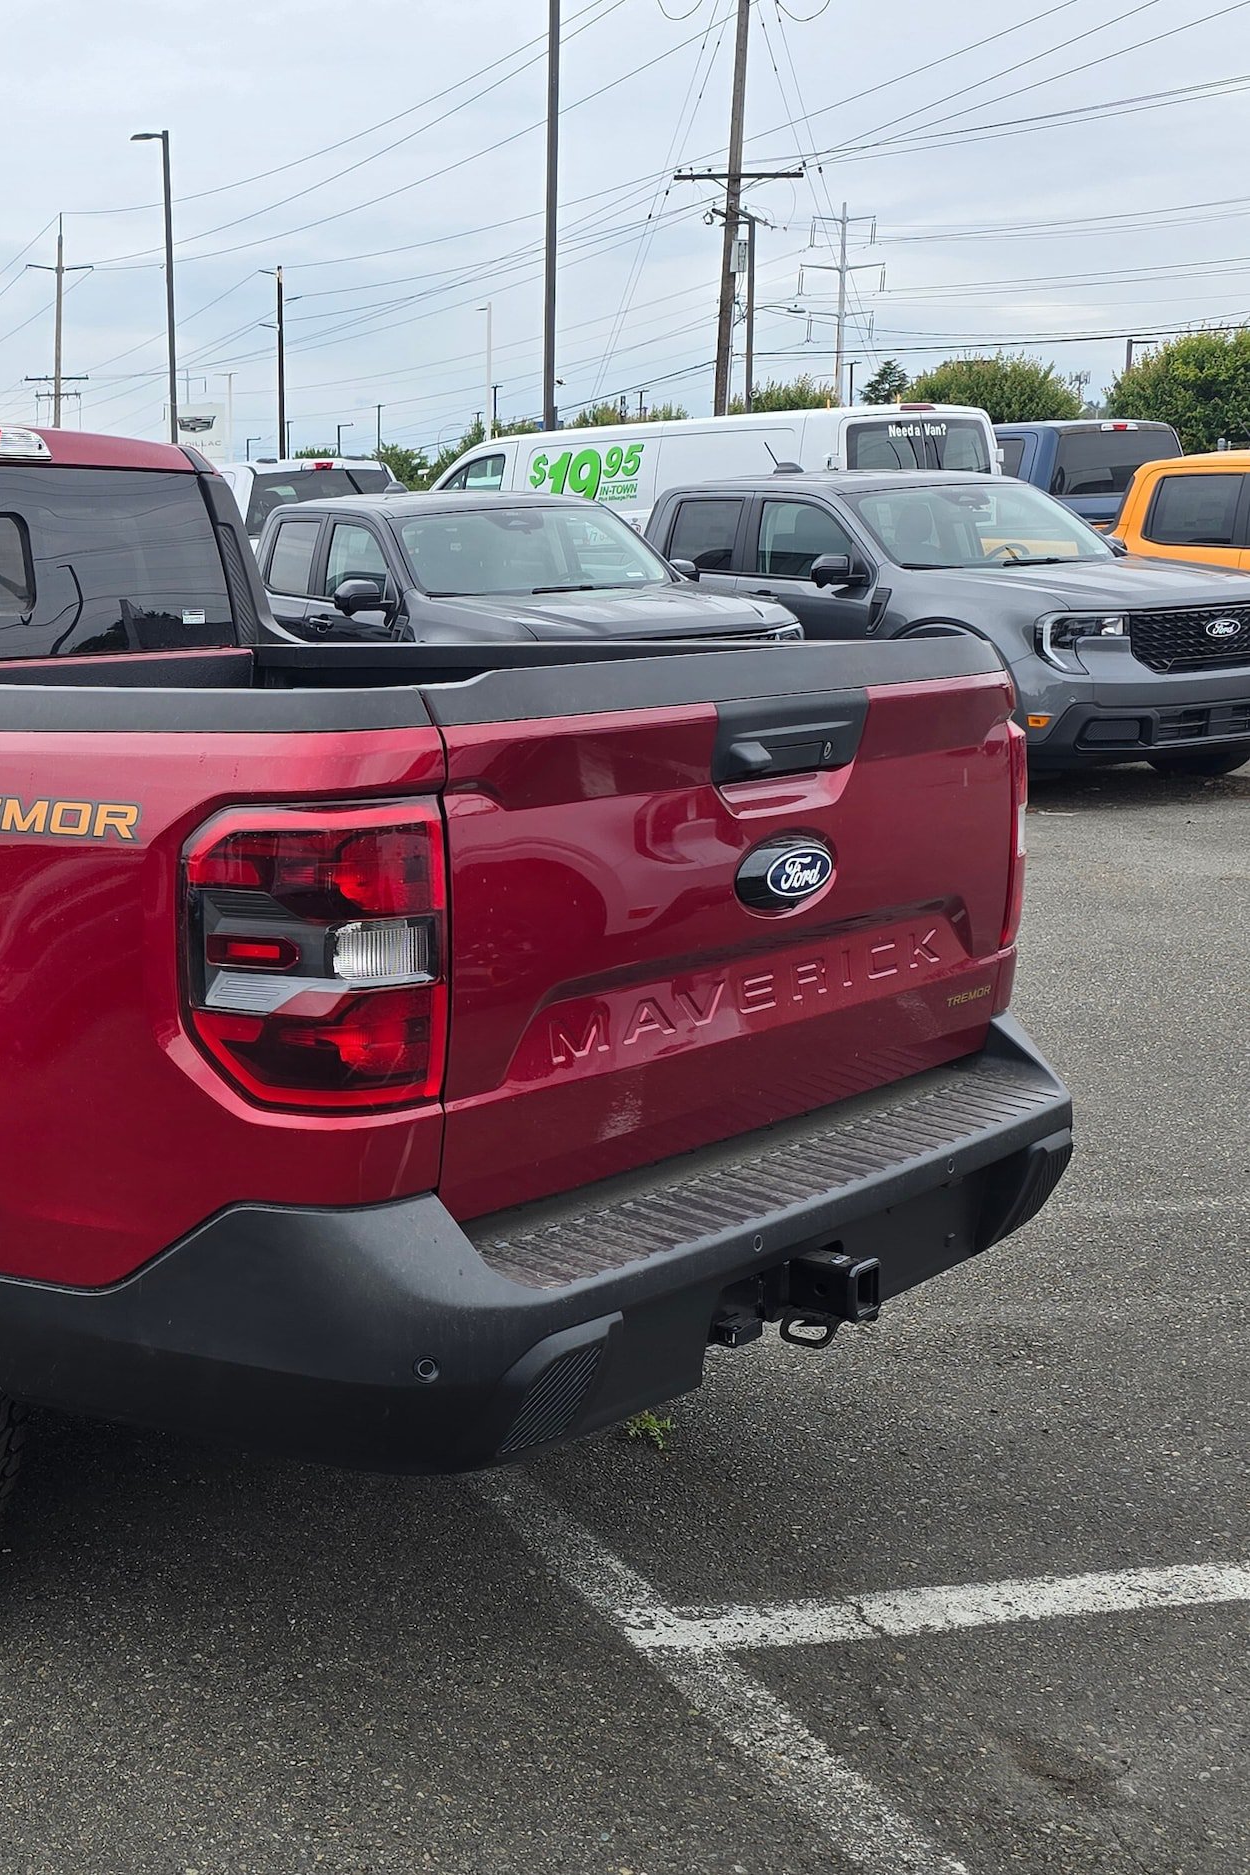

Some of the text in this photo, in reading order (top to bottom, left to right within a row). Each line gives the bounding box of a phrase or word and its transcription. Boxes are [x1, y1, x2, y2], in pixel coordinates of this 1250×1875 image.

[888, 423, 947, 437] Need a Van?
[599, 483, 638, 495] IN-TOWN
[1211, 621, 1236, 635] Ford
[779, 854, 823, 891] Ford
[549, 928, 941, 1064] MAVERICK
[946, 985, 992, 1007] TREMOR
